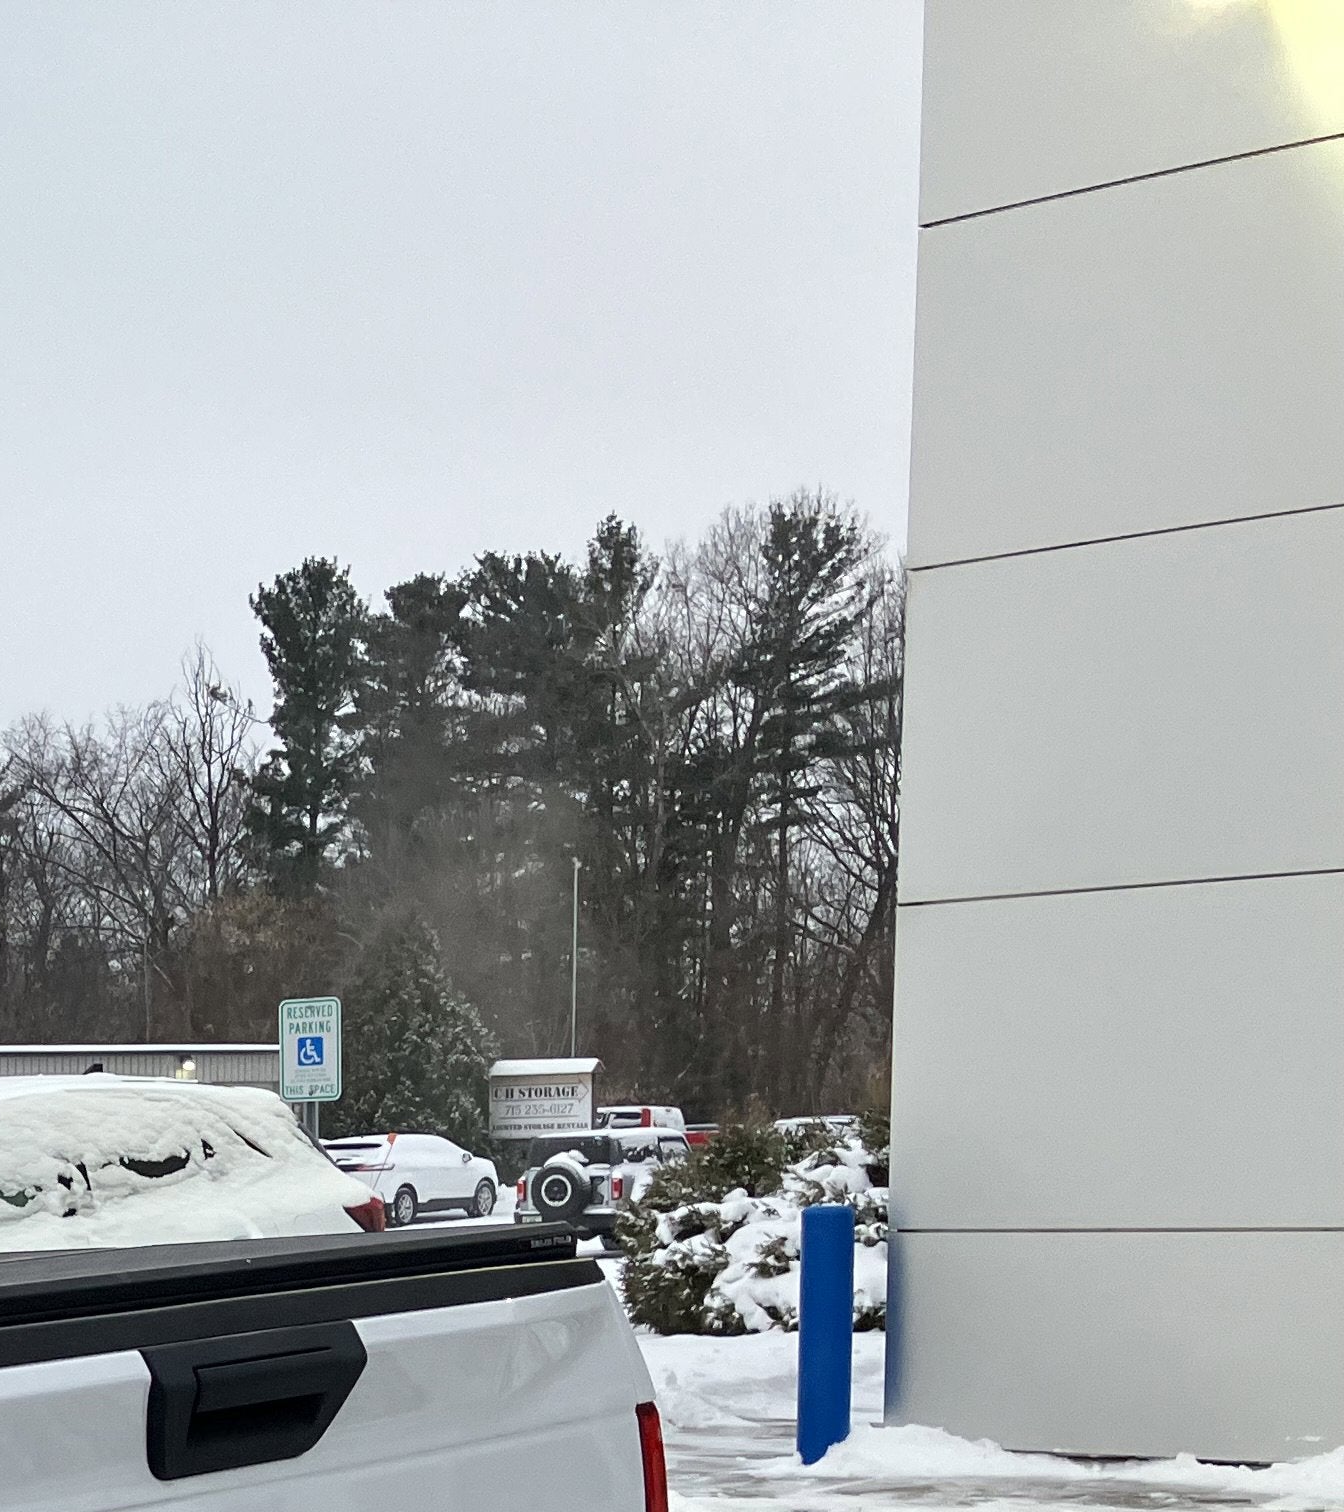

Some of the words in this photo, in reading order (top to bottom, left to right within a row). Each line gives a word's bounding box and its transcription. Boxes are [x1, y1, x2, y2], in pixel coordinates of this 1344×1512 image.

[287, 1004, 333, 1019] RESERVED
[289, 1020, 332, 1034] PARKING
[285, 1085, 304, 1096] THIS
[309, 1083, 336, 1096] SPACE
[518, 1086, 579, 1098] STORAGE
[504, 1103, 522, 1115] 715
